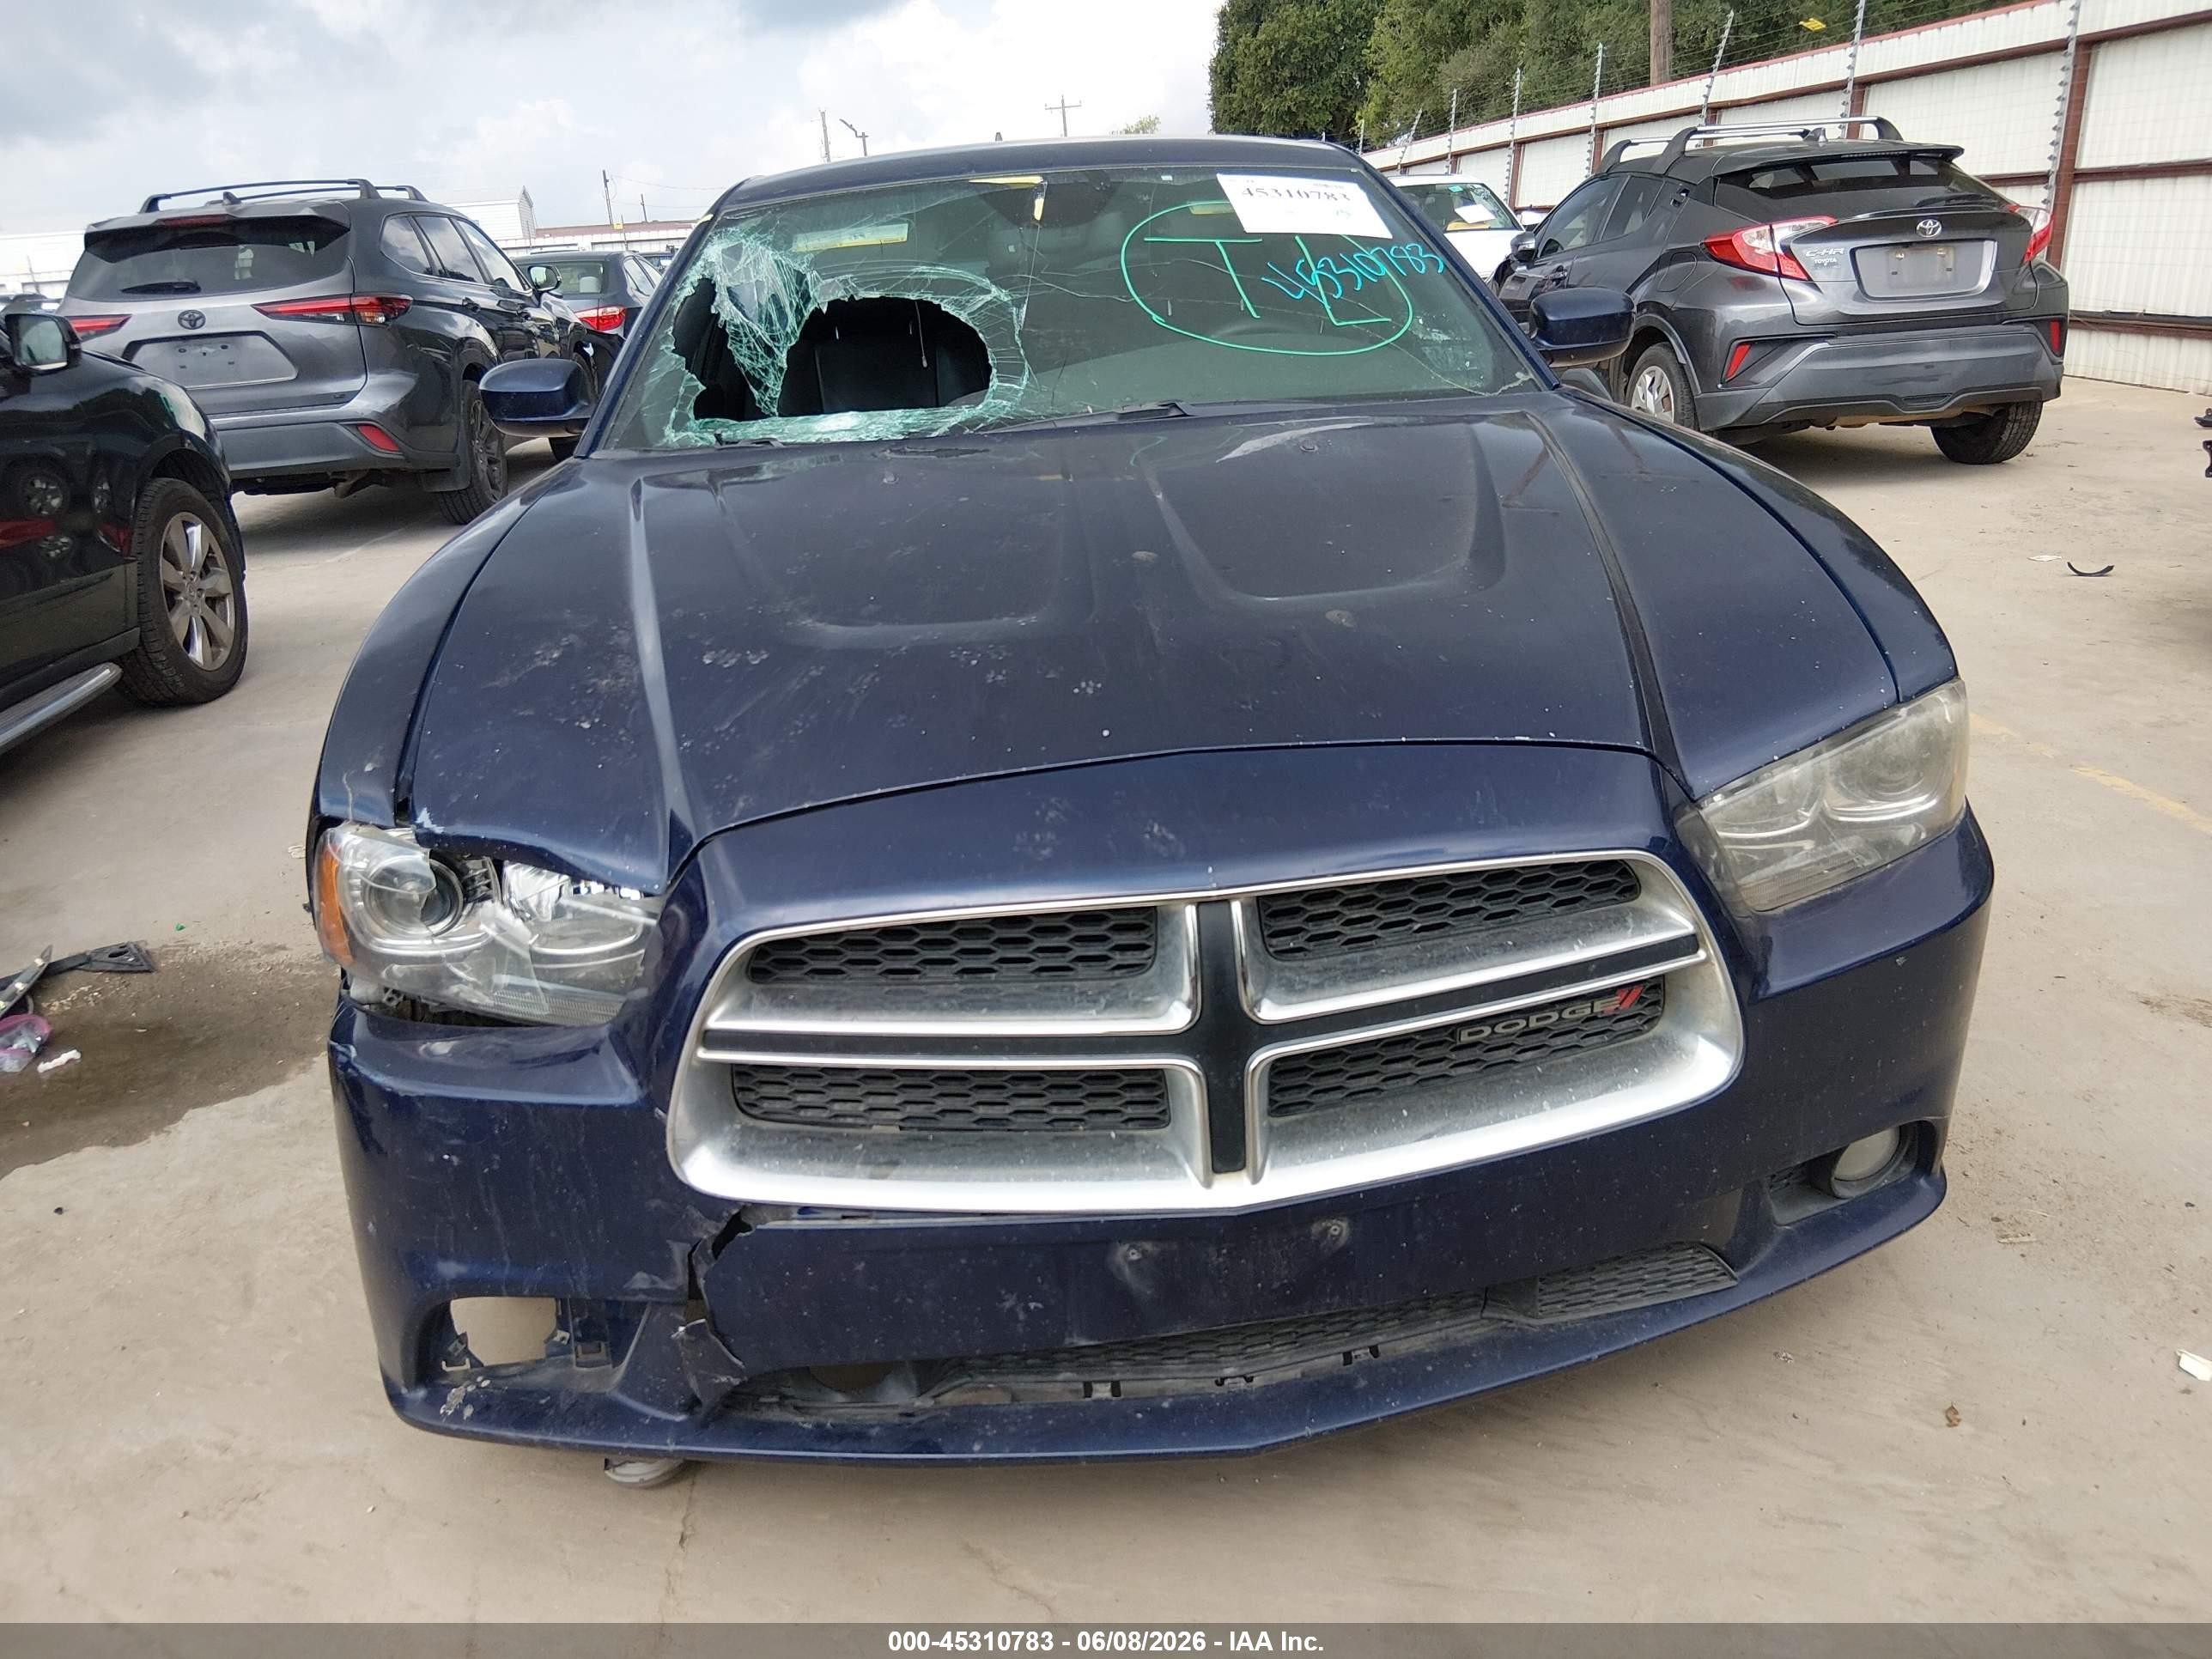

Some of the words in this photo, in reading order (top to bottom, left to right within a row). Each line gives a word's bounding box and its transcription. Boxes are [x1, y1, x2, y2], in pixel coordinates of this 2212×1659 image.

[1806, 248, 1844, 257] C-HR
[1144, 236, 1262, 319] T
[1295, 234, 1392, 326] L
[1460, 996, 1620, 1043] DODGE
